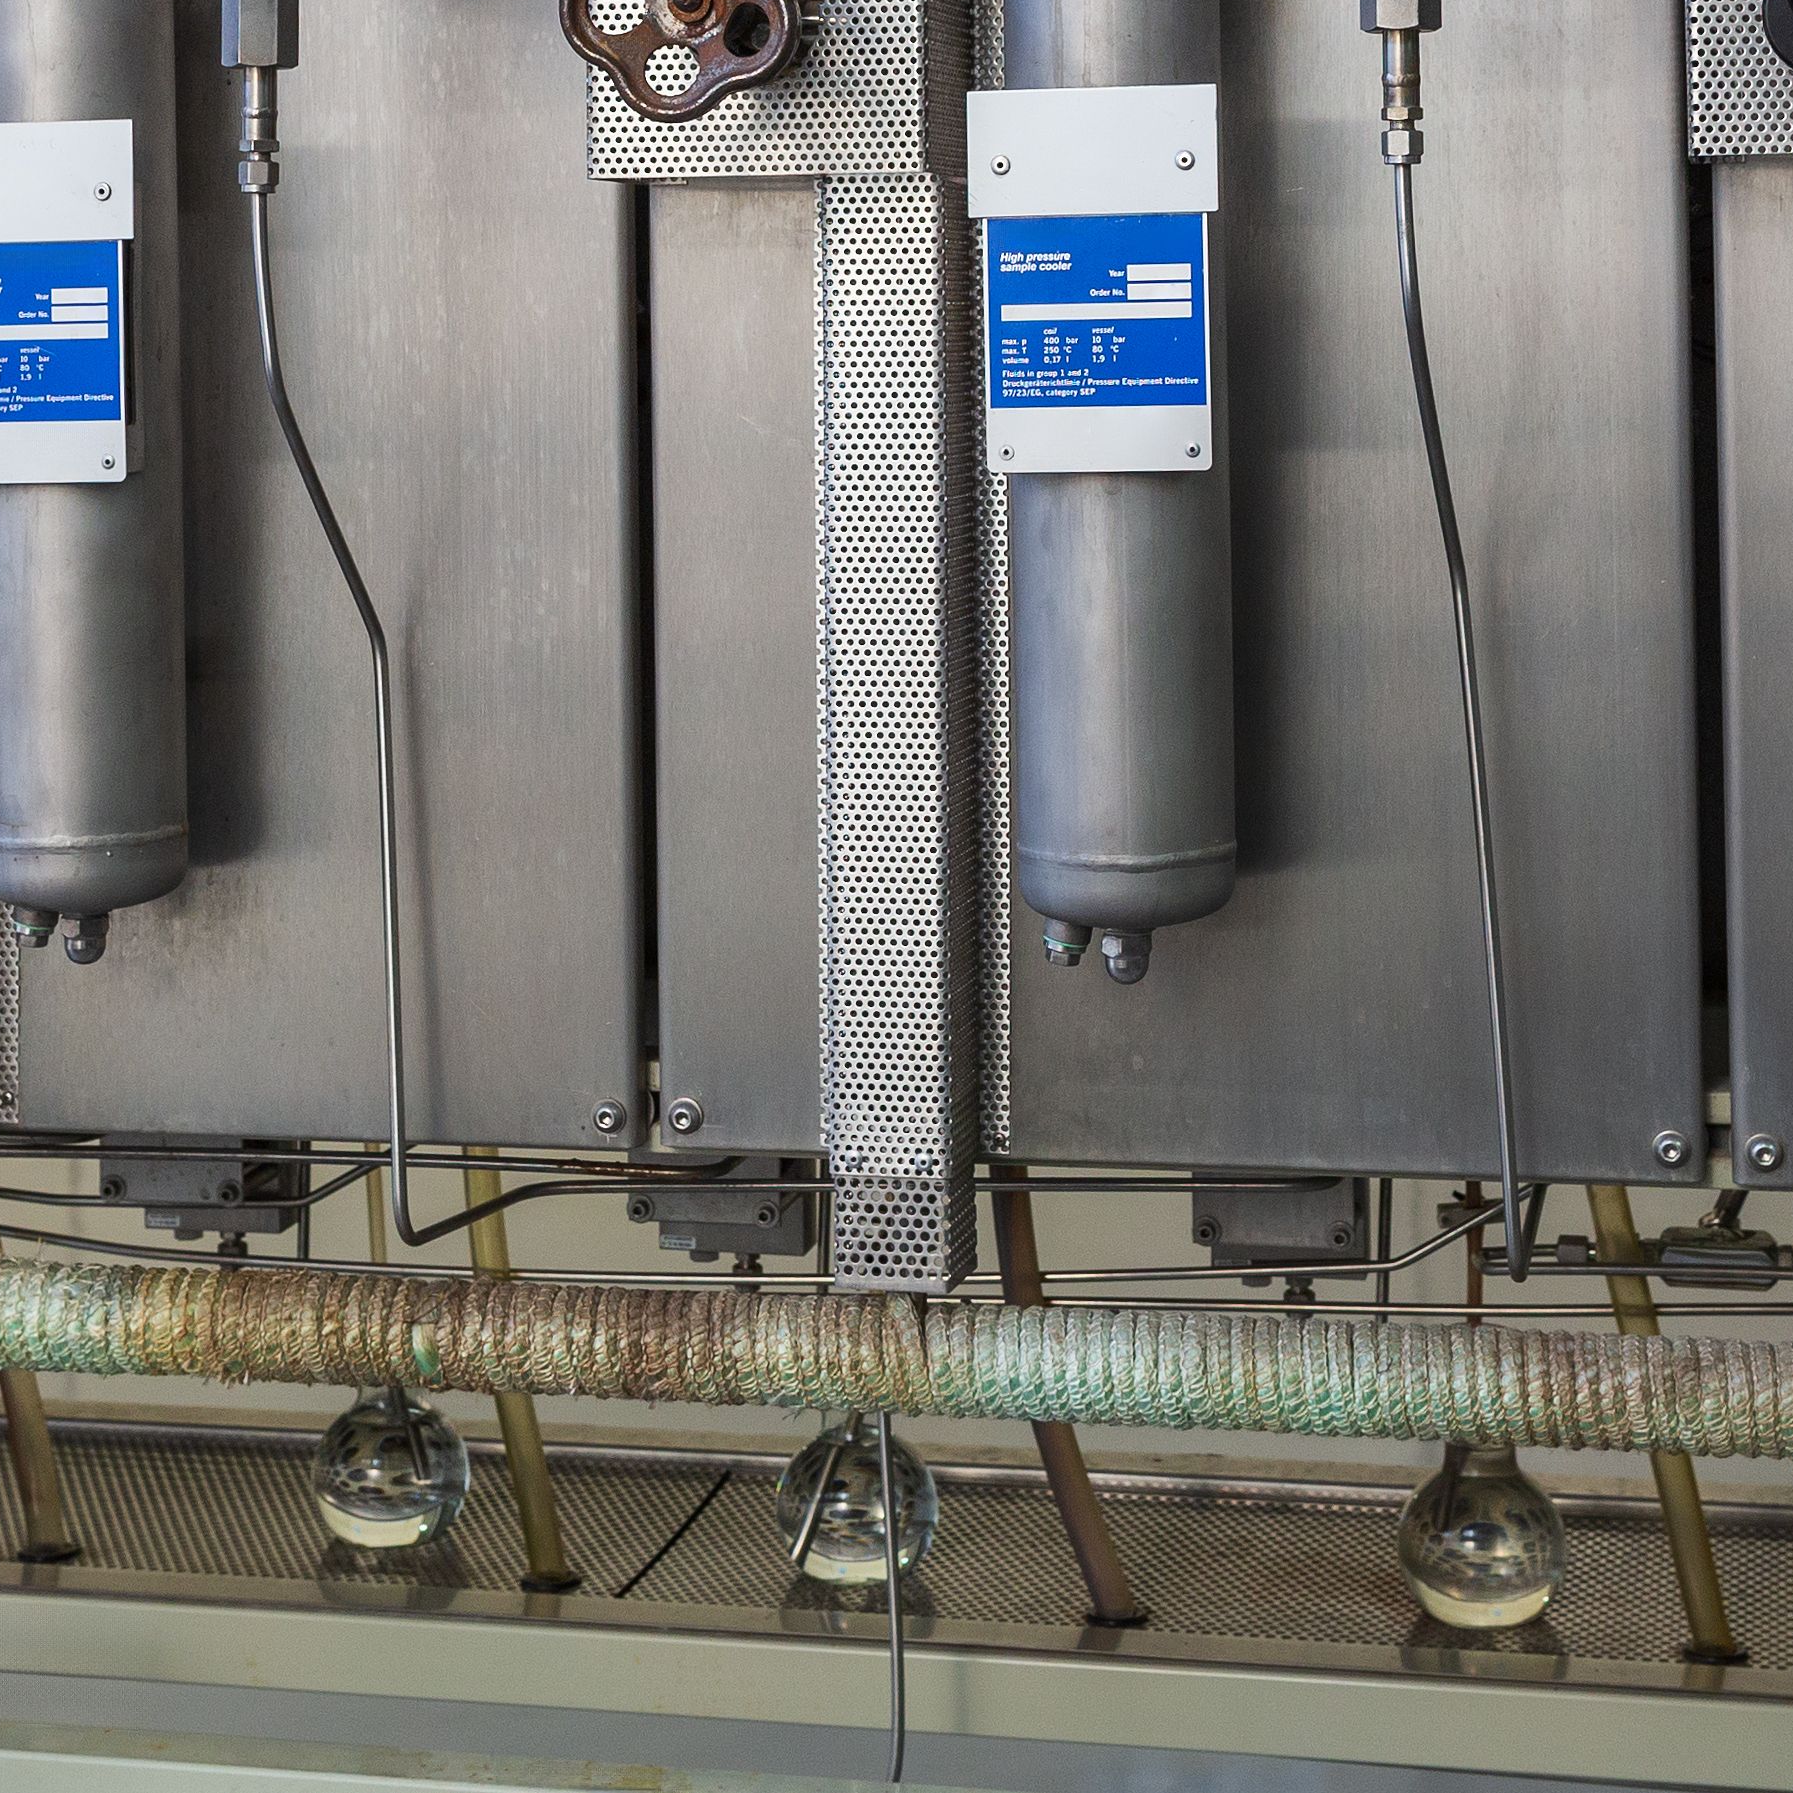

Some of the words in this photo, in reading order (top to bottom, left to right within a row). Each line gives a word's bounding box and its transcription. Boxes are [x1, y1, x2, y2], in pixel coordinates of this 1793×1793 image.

[1000, 253, 1024, 262] High
[1026, 252, 1070, 263] pressure
[1000, 263, 1037, 273] sample
[1039, 262, 1072, 271] cooler
[1112, 288, 1125, 296] No.
[1044, 346, 1059, 354] 250
[1092, 355, 1105, 363] 1.9
[1037, 370, 1058, 379] group
[1122, 377, 1162, 386] Equipment
[1165, 376, 1198, 384] Directive
[1046, 389, 1078, 397] category
[1080, 388, 1095, 396] SEP
